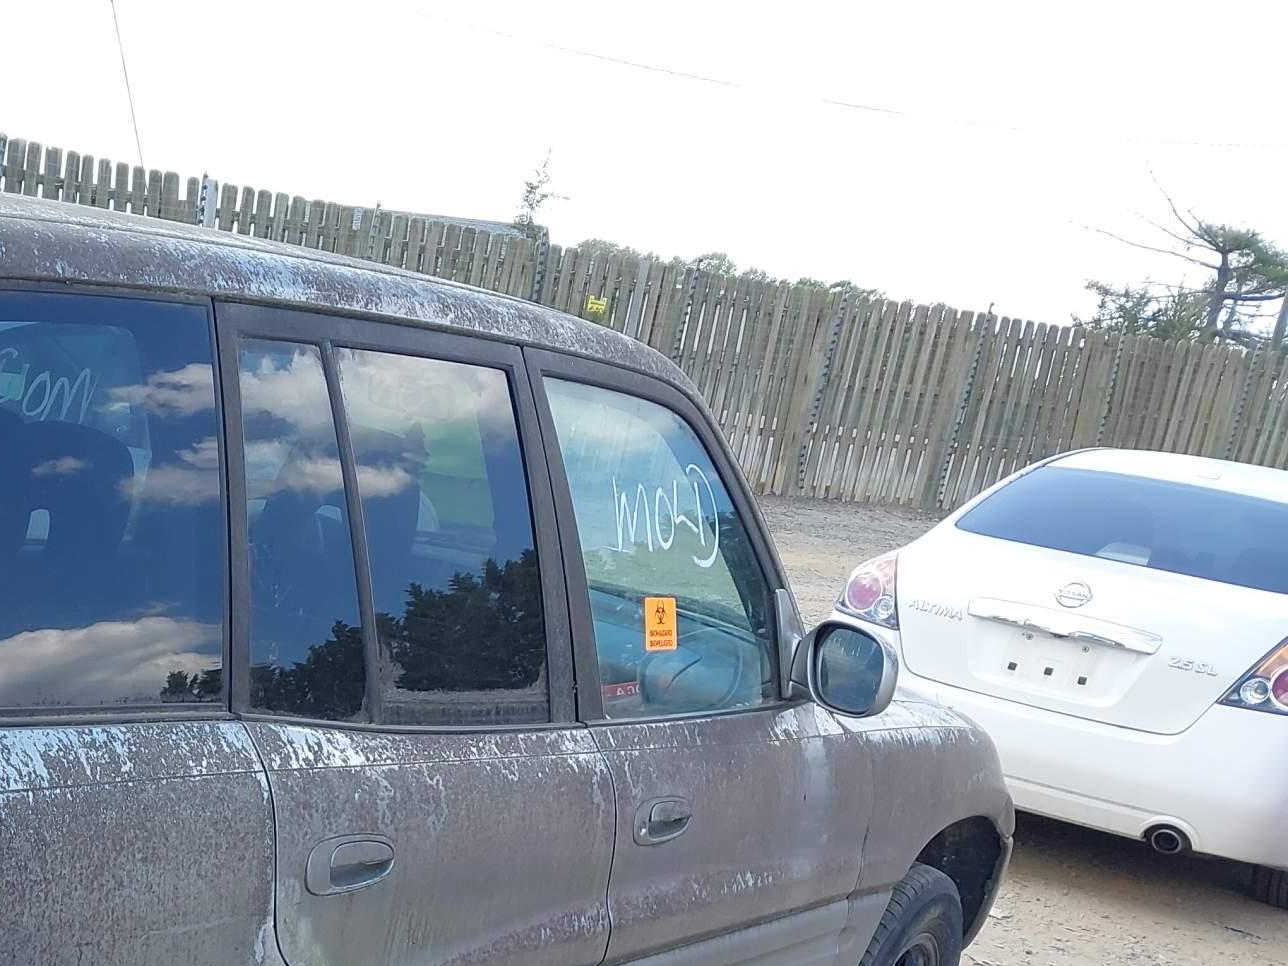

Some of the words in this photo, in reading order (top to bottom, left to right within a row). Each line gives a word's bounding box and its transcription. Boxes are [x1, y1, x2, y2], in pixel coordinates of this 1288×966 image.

[603, 463, 720, 568] MOLD
[908, 599, 963, 622] ALTIMA
[650, 629, 673, 638] BIOHAZARD
